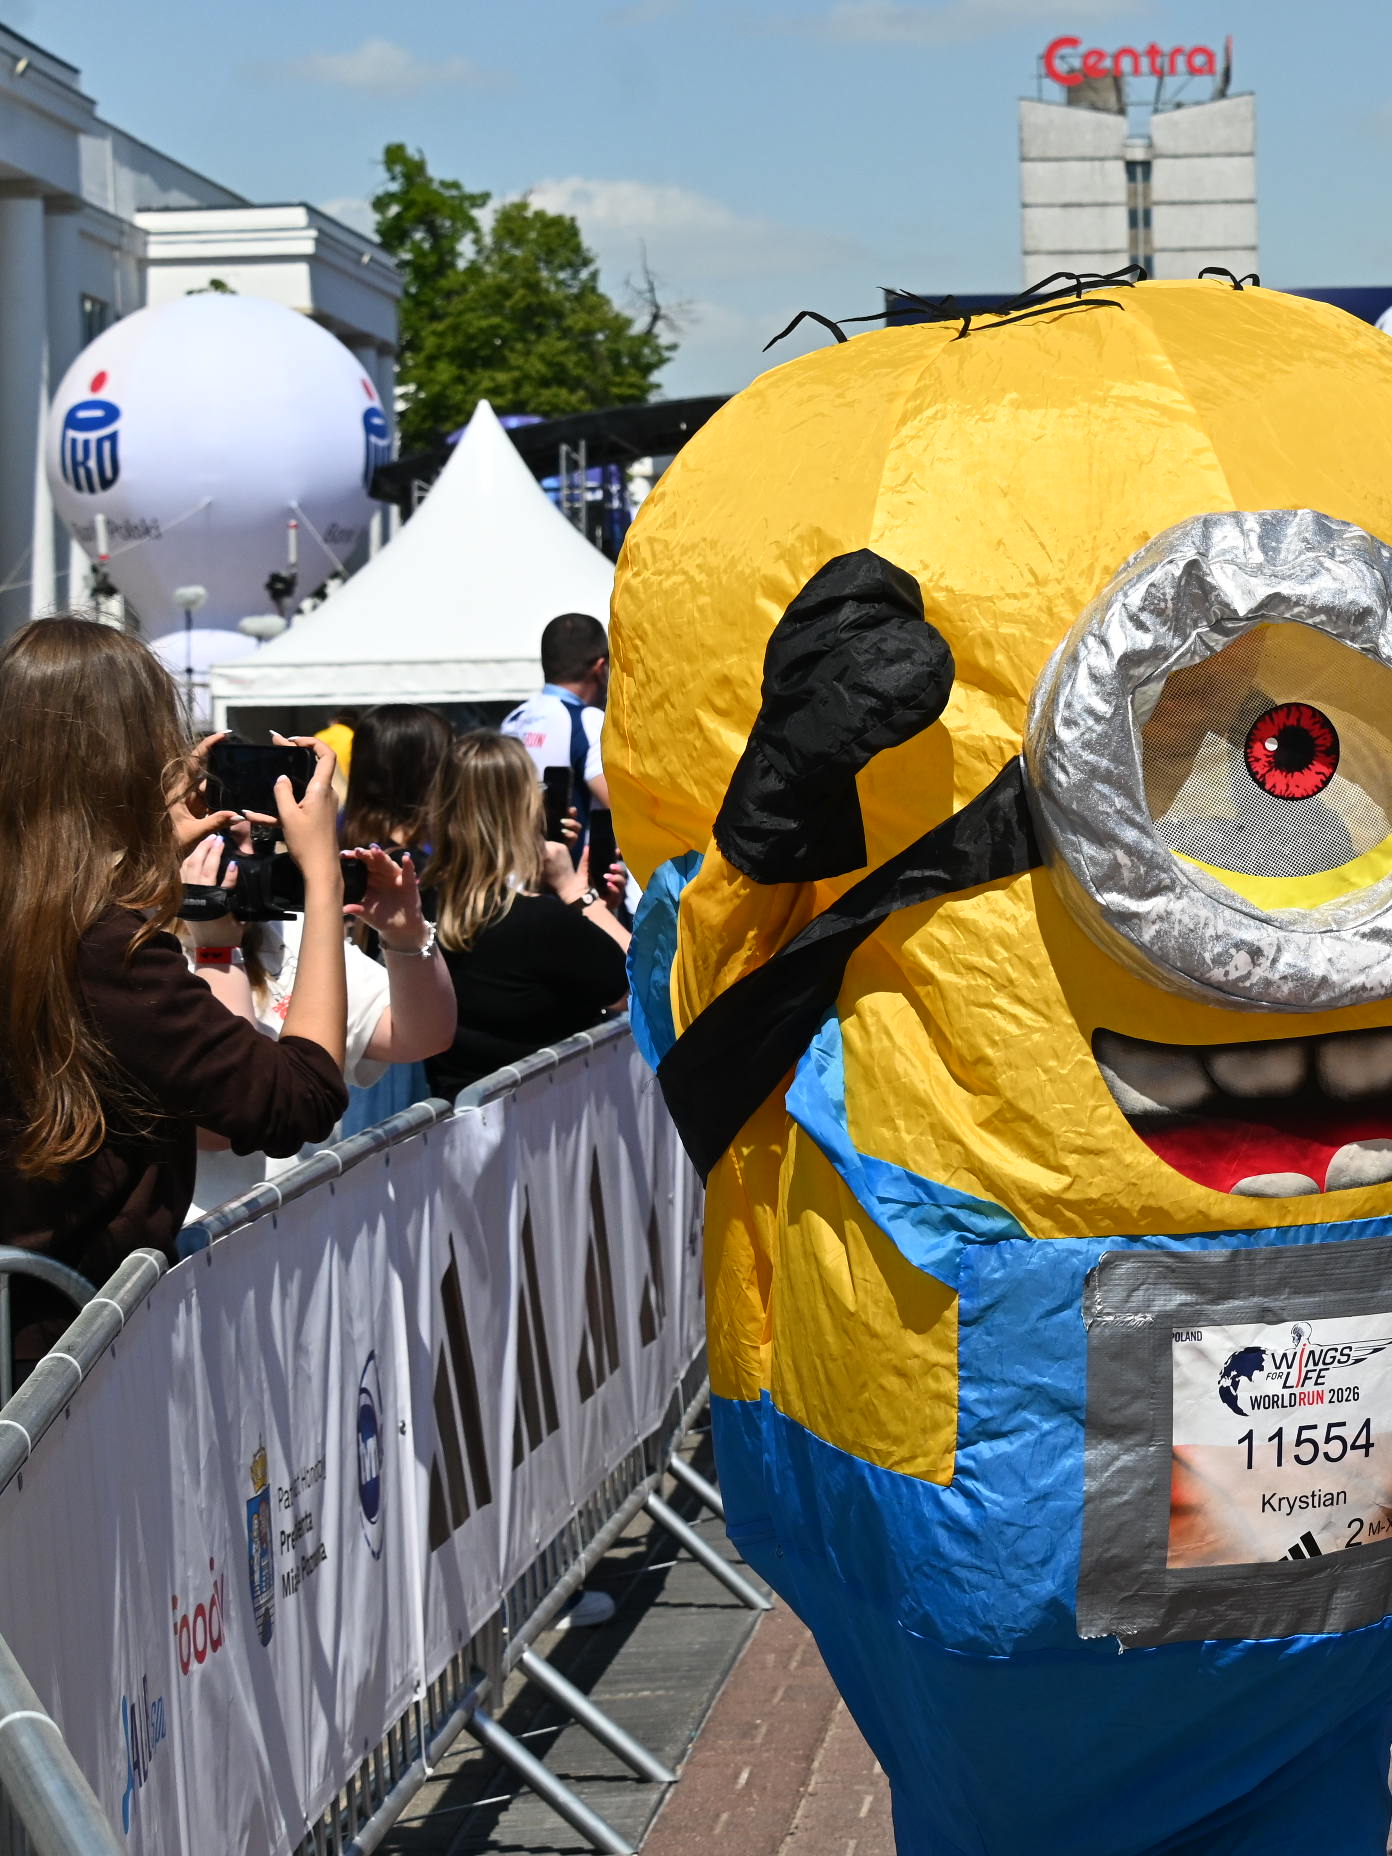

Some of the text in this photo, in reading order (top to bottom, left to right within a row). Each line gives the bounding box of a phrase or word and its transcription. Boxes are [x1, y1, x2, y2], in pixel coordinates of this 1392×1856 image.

[1270, 1343, 1354, 1370] WINGS
[1265, 1367, 1330, 1390] FOR LIFE
[1249, 1386, 1360, 1411] WORLD RUN 2026
[1237, 1417, 1375, 1470] 11554
[1260, 1488, 1347, 1517] Krystian
[1344, 1517, 1364, 1549] 2
